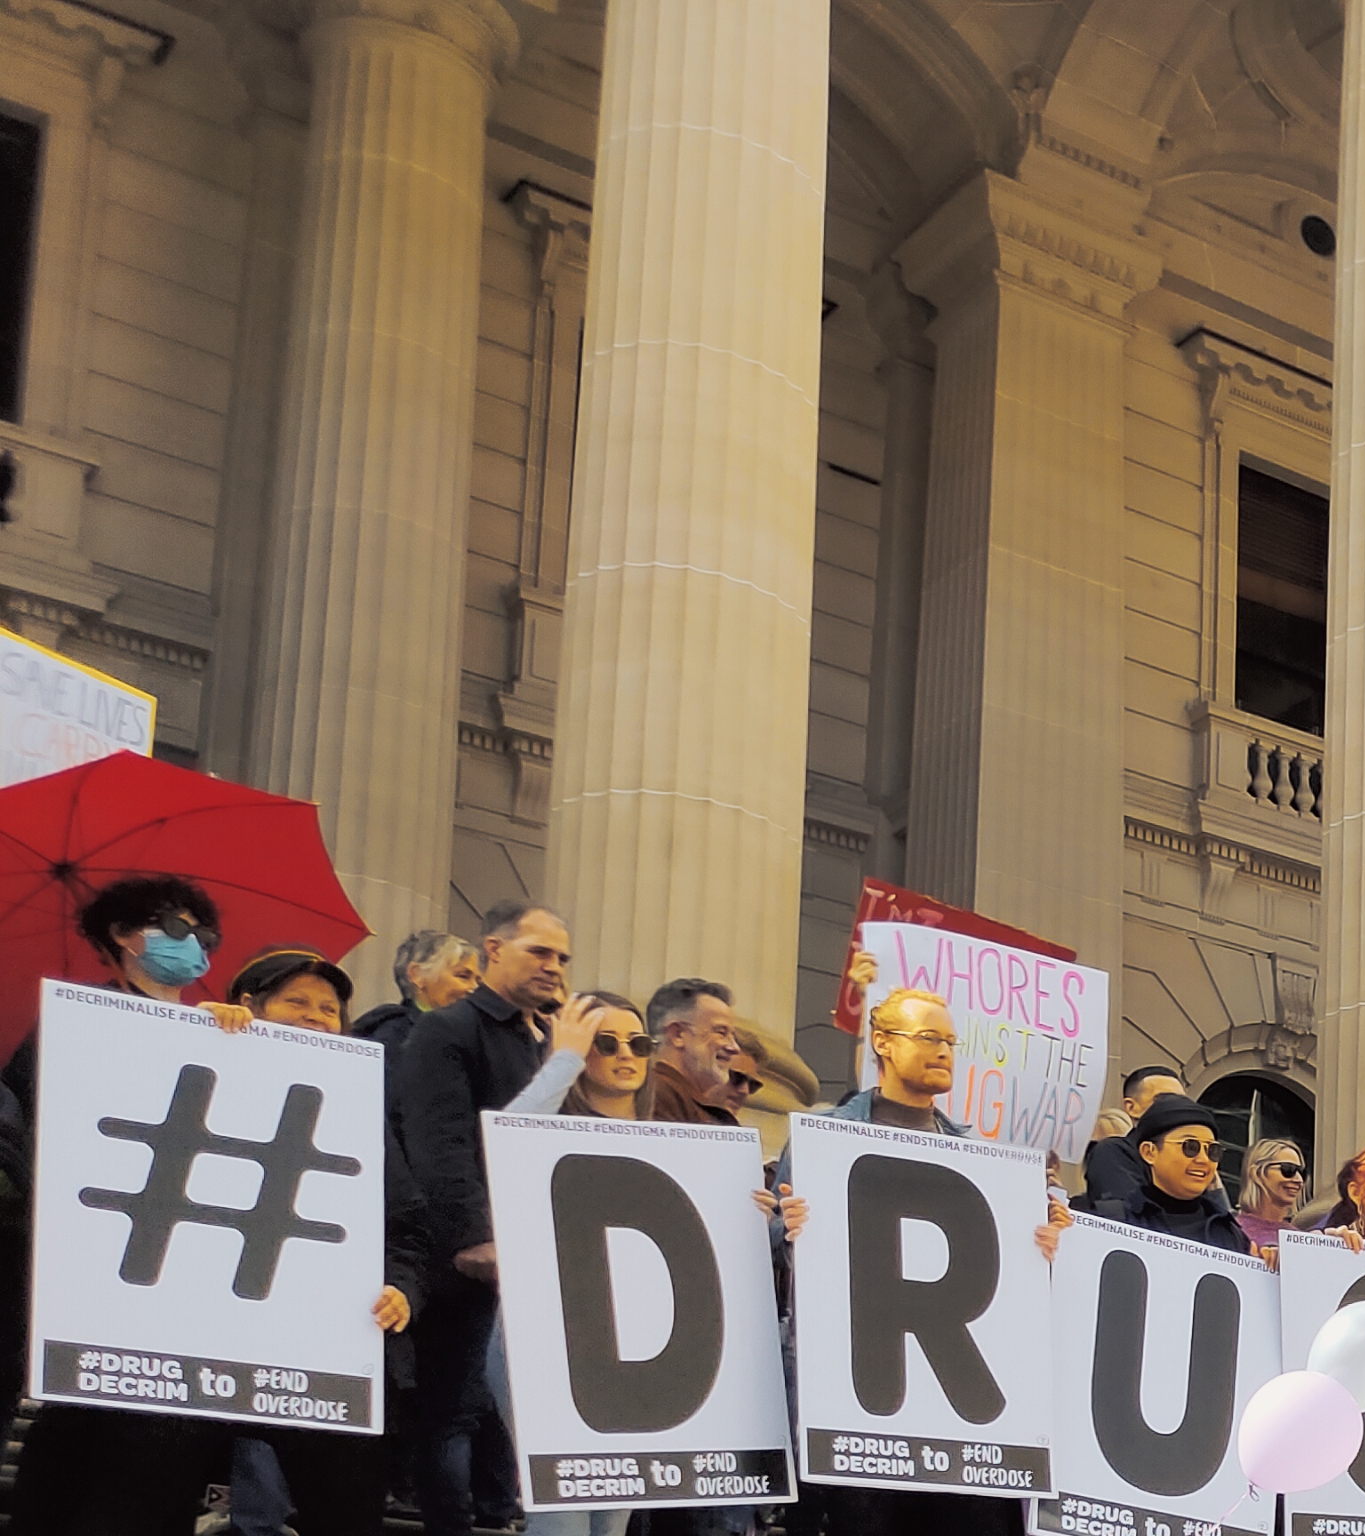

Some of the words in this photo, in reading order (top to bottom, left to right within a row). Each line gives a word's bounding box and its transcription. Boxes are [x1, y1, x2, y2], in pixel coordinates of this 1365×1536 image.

[79, 681, 149, 747] LIVES
[894, 930, 1086, 1038] WHORES
[55, 987, 176, 1020] #DECRIMINALISE
[273, 1030, 382, 1059] #ENDOVERDOSE
[1042, 1033, 1094, 1088] THE
[493, 1115, 592, 1132] #DECRIMINALISE
[594, 1123, 667, 1138] #ENDSTIGMA
[669, 1127, 757, 1143] #ENDOVERDOSE
[800, 1117, 891, 1140] #DECRIMINALISE
[892, 1132, 961, 1152] #ENDSTIGMA
[1009, 1076, 1085, 1158] WAR
[78, 1063, 362, 1301] #
[1146, 1234, 1209, 1259] #ENDSTIGMA
[550, 1153, 726, 1434] D
[847, 1153, 1007, 1425] R
[78, 1372, 188, 1402] DECRIM
[253, 1394, 349, 1421] OVERDOSE
[79, 1350, 184, 1380] #DRUG
[200, 1367, 236, 1398] to
[253, 1369, 309, 1393] #END
[1091, 1249, 1241, 1497] U
[556, 1458, 639, 1477] #DRUG
[650, 1460, 682, 1487] to
[692, 1452, 737, 1474] #END
[832, 1435, 910, 1457] #DRUG
[921, 1445, 950, 1472] to
[961, 1444, 1003, 1465] #END
[833, 1454, 915, 1477] DECRIM
[962, 1466, 1034, 1488] OVERDOSE
[557, 1477, 646, 1497] DECRIM
[695, 1475, 770, 1496] OVERDOSE
[1061, 1498, 1134, 1526] #DRUG
